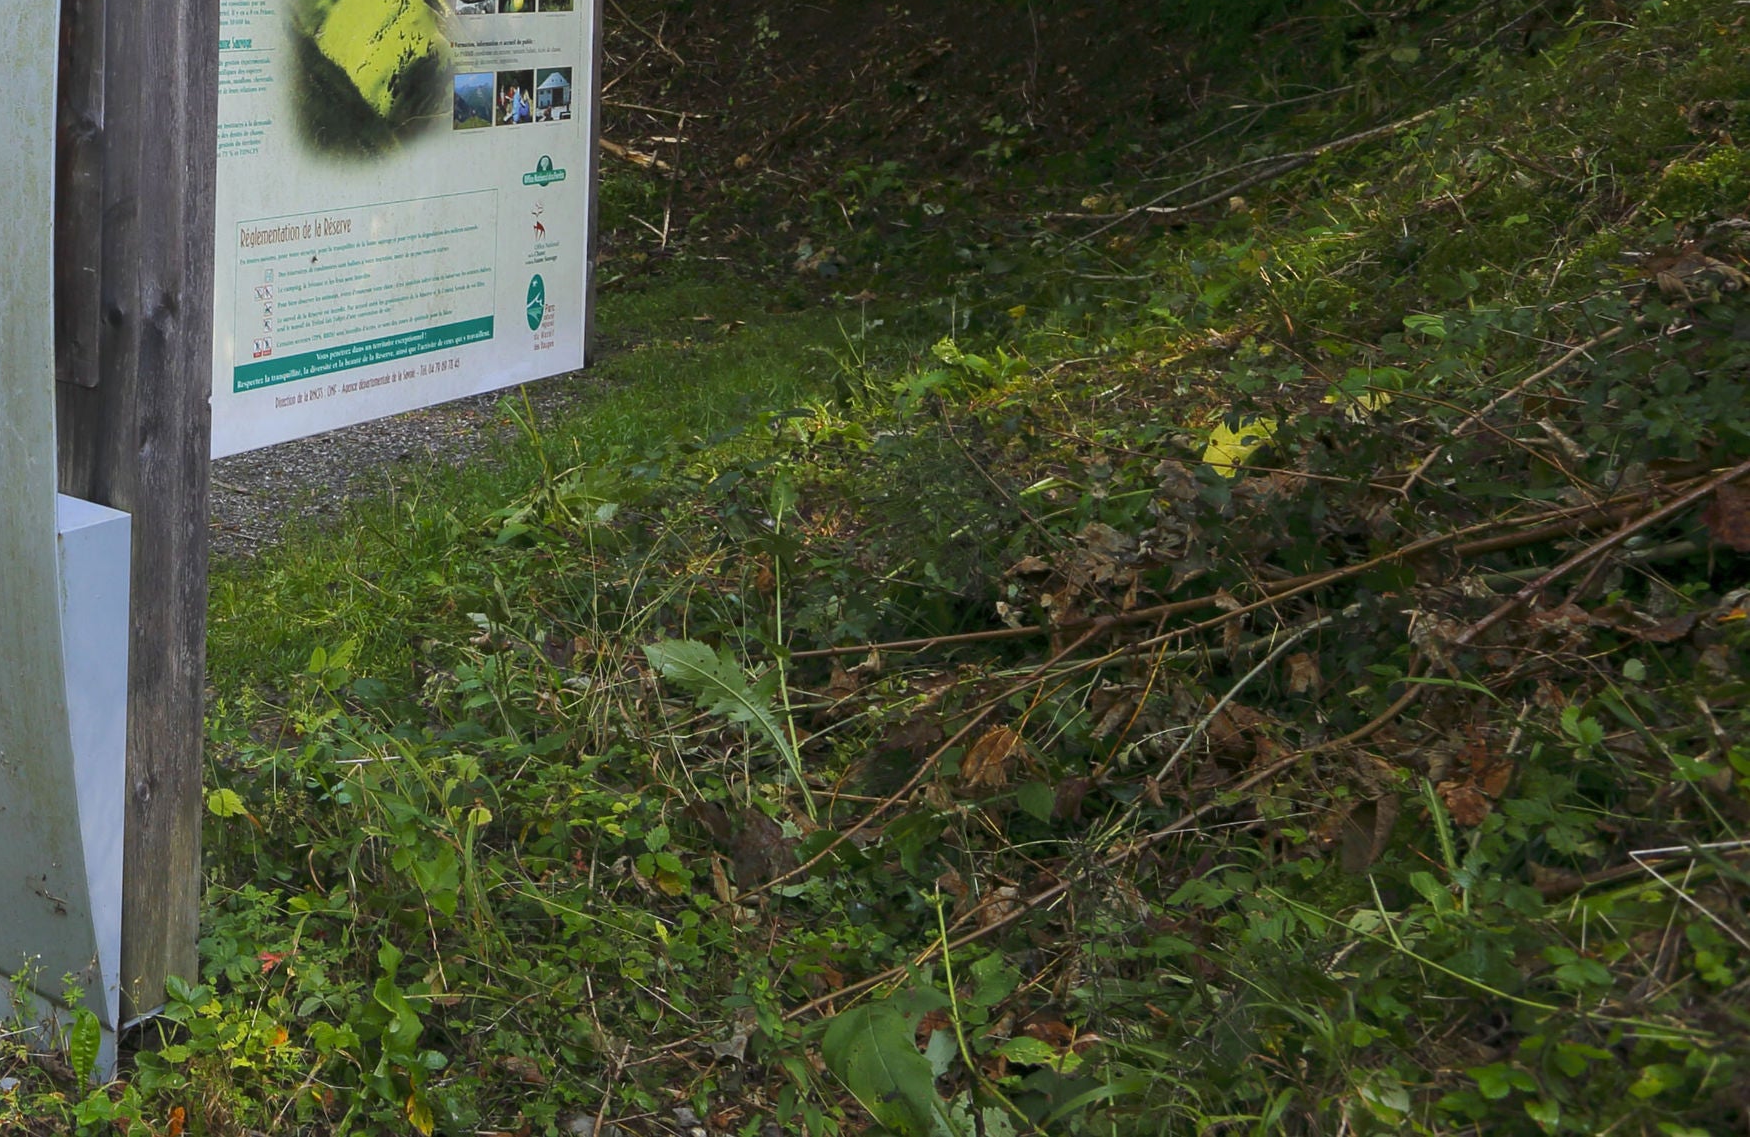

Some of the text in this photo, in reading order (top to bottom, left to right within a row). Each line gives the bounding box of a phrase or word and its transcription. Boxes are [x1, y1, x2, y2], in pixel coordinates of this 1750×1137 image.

[303, 220, 312, 240] de
[314, 219, 322, 238] la
[323, 215, 351, 237] Réserve
[237, 377, 263, 389] Respectez
